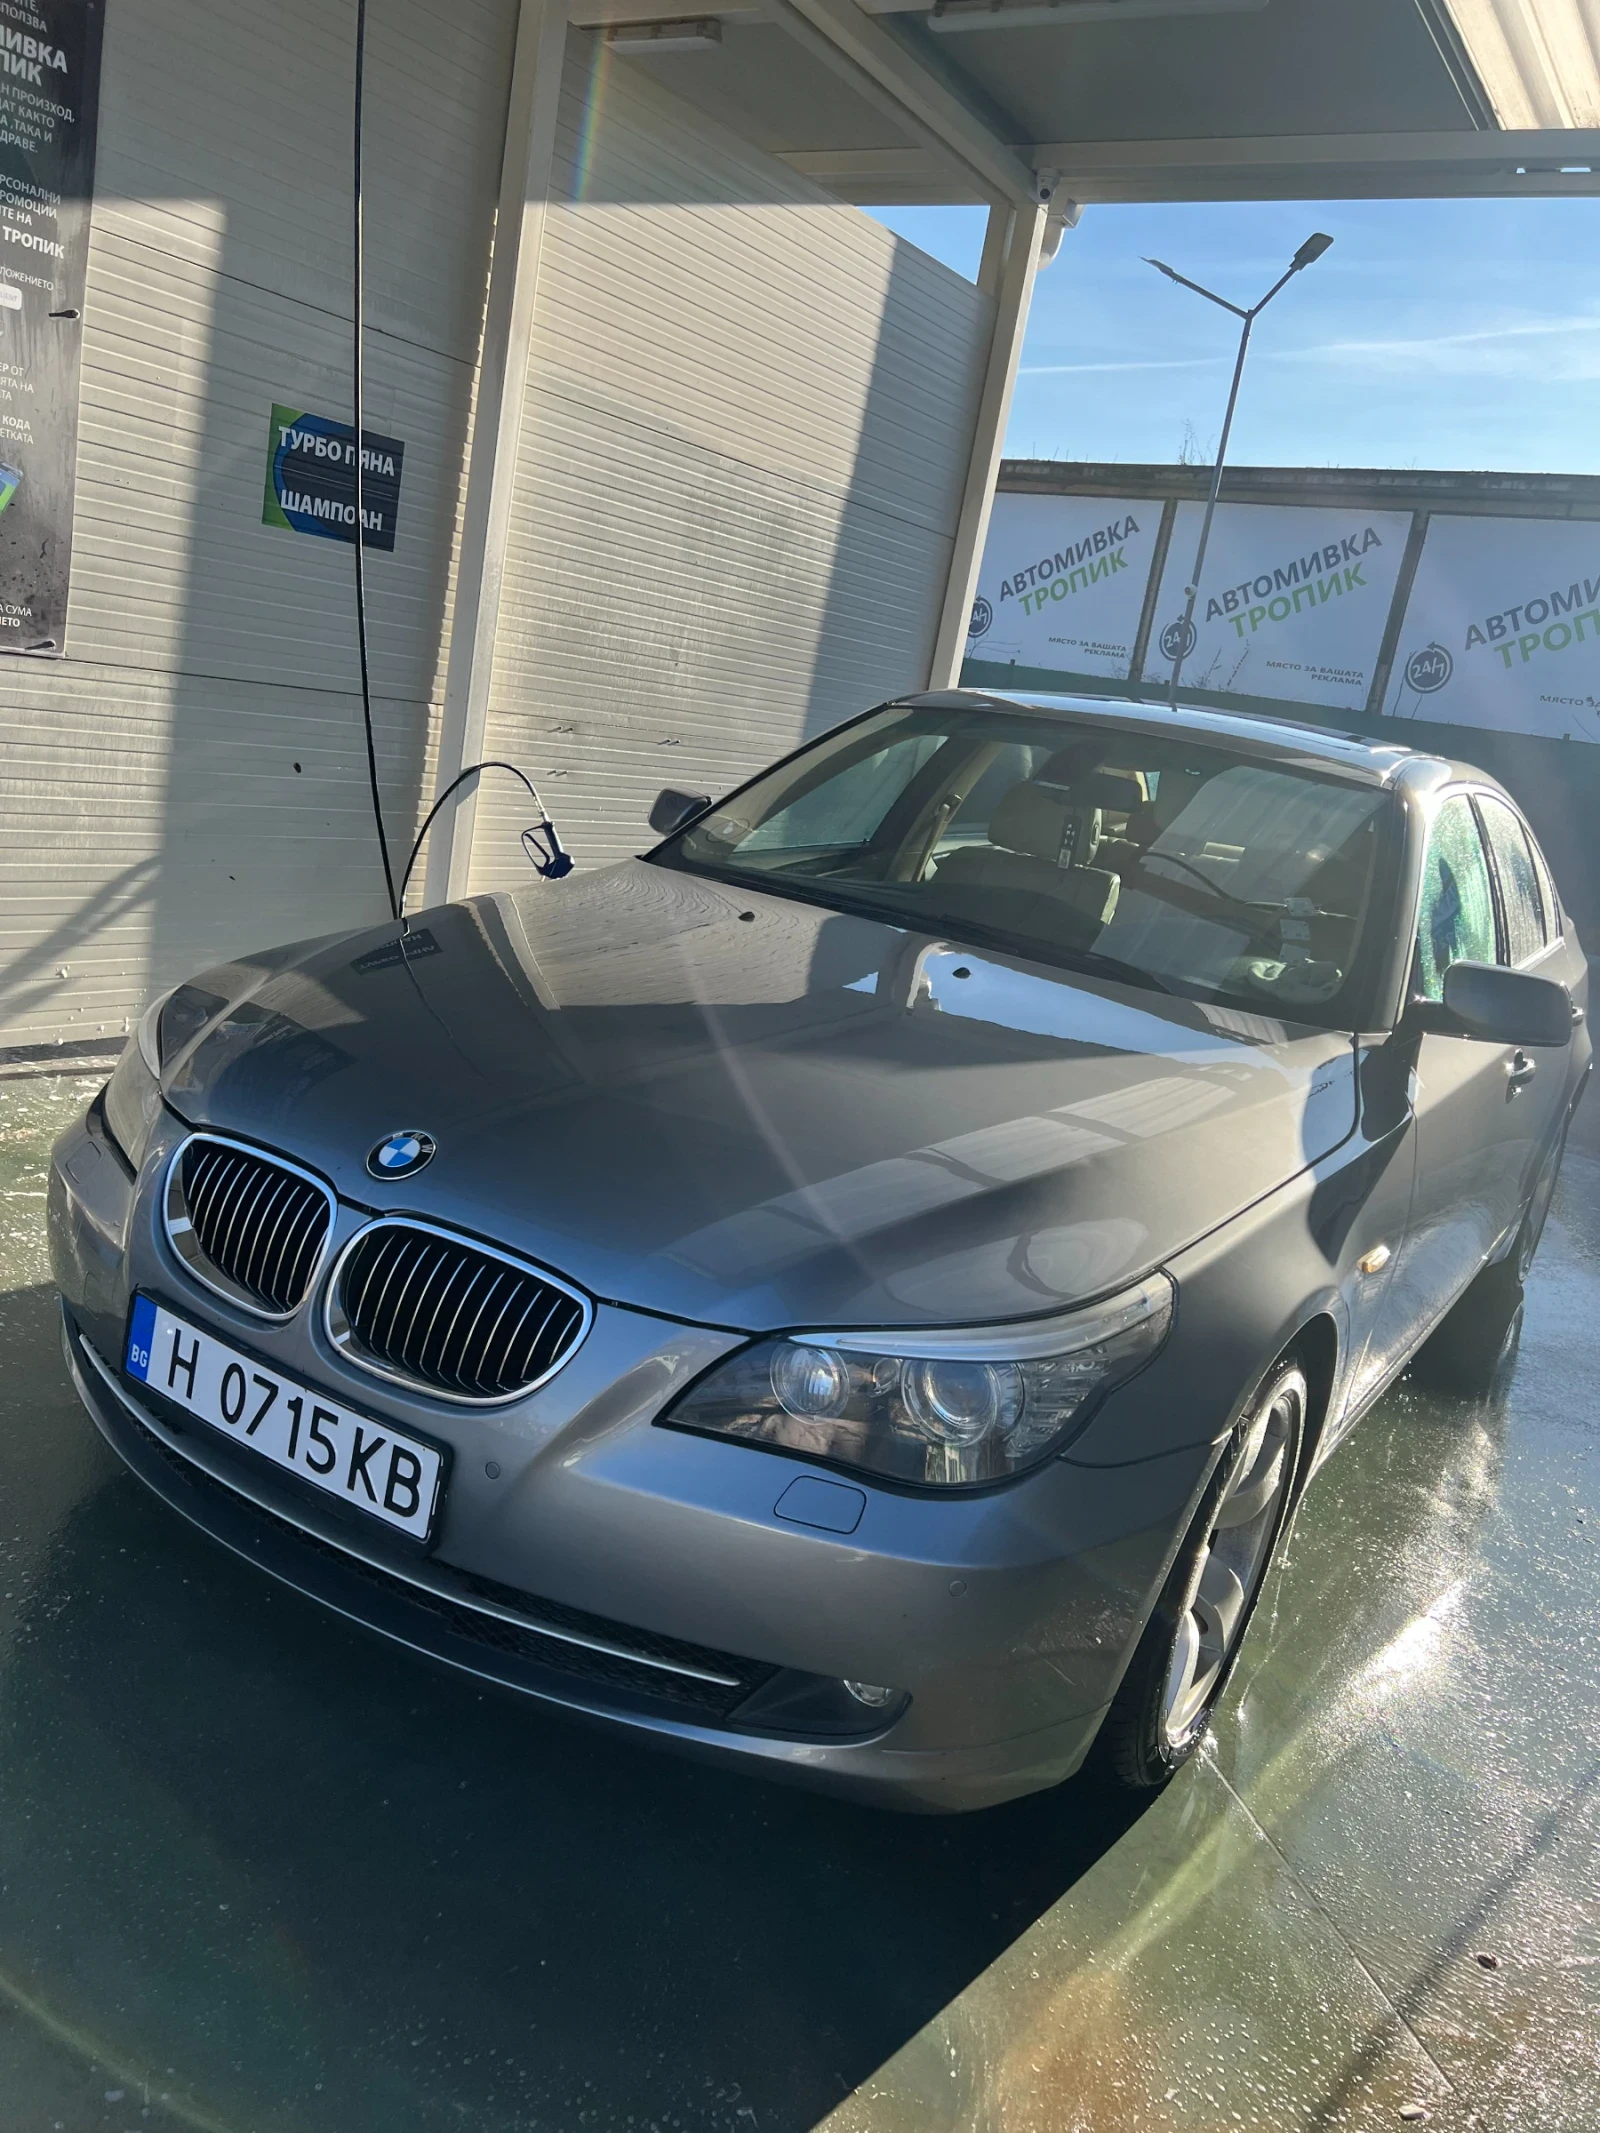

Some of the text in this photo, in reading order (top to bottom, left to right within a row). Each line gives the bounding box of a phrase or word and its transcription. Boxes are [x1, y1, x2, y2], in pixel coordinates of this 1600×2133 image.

[0, 2, 48, 33] ПОЛЗВА
[12, 86, 76, 123] ПРОИЗХОД,
[18, 105, 55, 128] КАКТО
[44, 130, 53, 143] И
[0, 205, 33, 226] ТЕ НА
[2, 225, 65, 260] ТРОПИК
[11, 366, 24, 376] ОТ
[0, 389, 13, 401] ТА
[20, 381, 34, 394] НА
[2, 415, 31, 431] КОДА
[0, 427, 34, 445] ЕТКАТА
[278, 425, 395, 477] ТУРБО ПЯНА
[280, 489, 383, 531] ШАМПОАН
[999, 514, 1140, 602] АВТОМИВКА
[1018, 545, 1128, 617] ТРОПИК
[1205, 526, 1383, 623] АВТОМИВКА
[1227, 560, 1368, 638] ТРОПИК
[5, 604, 33, 617] СУМА
[970, 607, 988, 625] 4/7
[1048, 636, 1127, 652] МЯСТО ЗА ВАШАТА
[1492, 608, 1600, 670] ТРОП
[1083, 648, 1126, 659] РЕКЛАМА
[1266, 660, 1364, 679] МЯСТО ЗА ВАШАТА
[1411, 657, 1445, 679] 24/7
[1310, 673, 1362, 686] РЕКЛАМА
[1540, 694, 1584, 706] МЯСТО
[130, 1343, 148, 1368] BG
[167, 1328, 200, 1400] H
